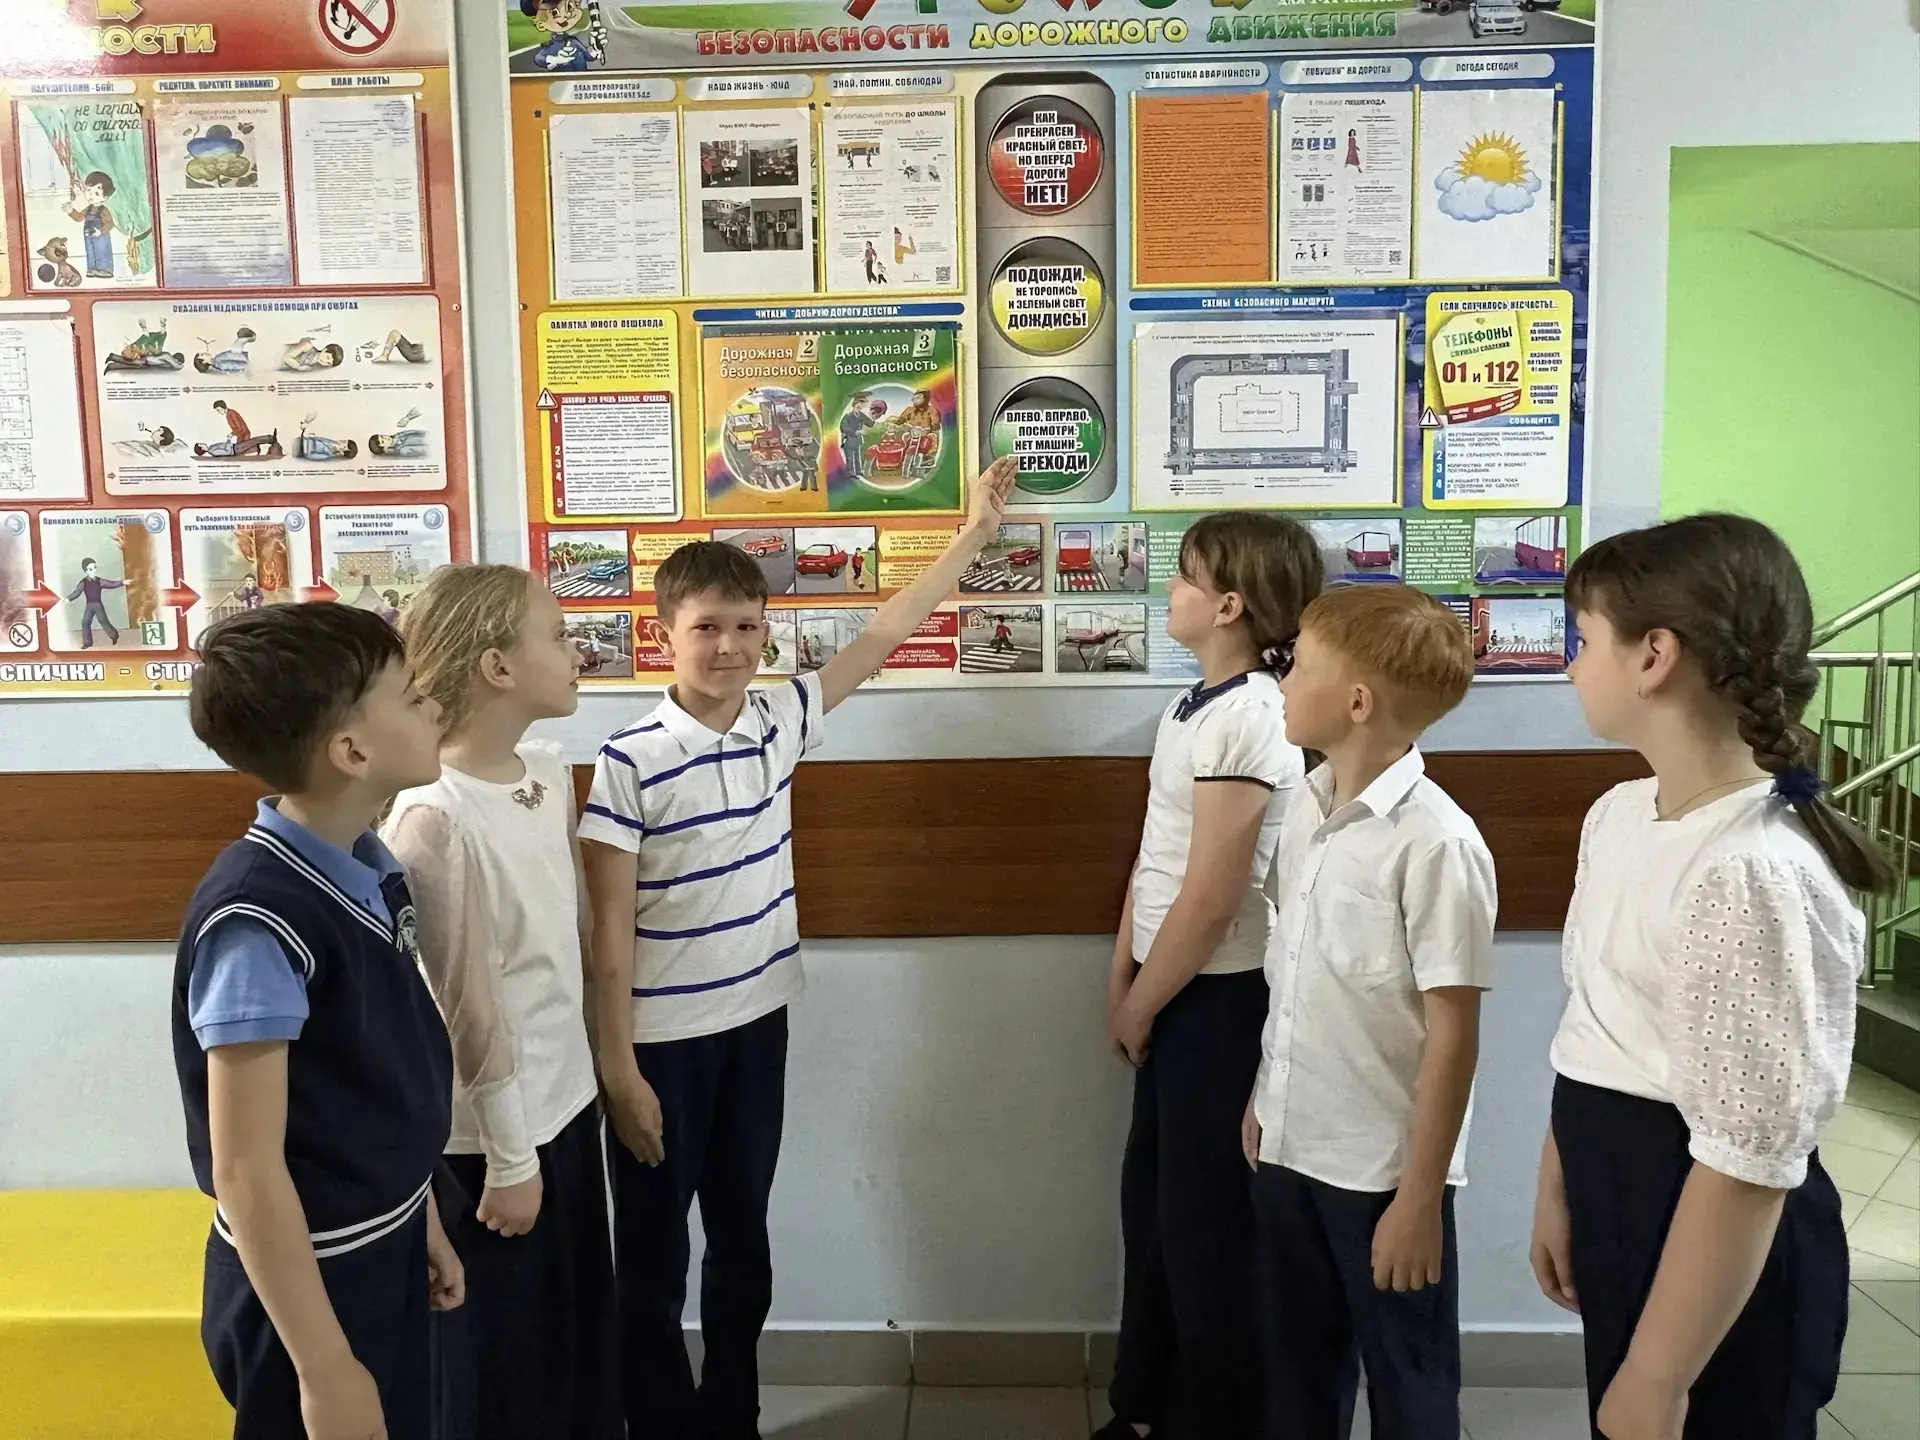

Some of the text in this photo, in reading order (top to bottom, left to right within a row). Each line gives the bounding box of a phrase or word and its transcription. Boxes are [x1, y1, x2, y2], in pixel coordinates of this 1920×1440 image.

[697, 12, 1397, 56] БЕЗОПАСНОСТИ ДОРОЖНОГО ДВИЖЕНИЯ
[1347, 67, 1357, 75] НА
[1358, 66, 1392, 75] ДОРОГАХ
[1456, 62, 1519, 72] ПОГОДА СЕГОДНЯ
[1145, 68, 1261, 80] СТАТИСТИКА АВАРИЙНОСТИ
[199, 79, 232, 90] ОБРАТИТЕ
[235, 79, 273, 89] ВНИМАНИЕ!
[331, 76, 390, 86] ПЛАН РАБОТЫ
[708, 82, 731, 92] НАША
[734, 82, 764, 91] ЖИЗНЬ
[771, 81, 790, 91] ЮИД
[1035, 113, 1056, 123] КАК
[1017, 126, 1074, 138] ПРЕКРАСЕН
[1006, 139, 1086, 152] КРАСНЫЙ СВЕТ,
[1018, 155, 1073, 166] НО ВПЕРЕД
[1025, 169, 1066, 180] ДОРОГИ
[1026, 185, 1066, 203] НЕТ!
[1008, 268, 1086, 284] ПОДОЖДИ,
[1016, 286, 1078, 296] НЕ ТОРОПИСЬ
[173, 303, 212, 313] ОКАЗАНИЕ
[214, 303, 273, 313] МЕДИЦИНСКОЙ
[311, 303, 326, 311] ПРИ
[327, 302, 359, 311] ОЖОГАХ
[1008, 298, 1086, 309] И ЗЕЛЕНЫЙ СВЕТ
[1202, 297, 1334, 308] СХЕМЫ БЕЗОПАСНОГО МАРШРУТА
[1440, 301, 1461, 311] ЕСЛИ
[1462, 301, 1508, 311] СЛУЧИЛОСЬ
[755, 308, 787, 319] ЧИТАЕМ
[830, 307, 861, 318] ДОРОГУ
[551, 319, 664, 329] ПАМЯТКА ЮНОГО ПЕШЕХОДА
[1008, 312, 1087, 330] ДОЖДИСЬ!
[1443, 326, 1513, 347] ТЕЛЕФОНЫ
[719, 339, 814, 363] Дорожная 2
[834, 334, 929, 360] Дорожная 3
[1480, 341, 1510, 353] СПАСЕНИЯ
[720, 364, 820, 378] безопасность
[834, 360, 938, 376] безопасность
[1443, 362, 1467, 383] 01
[1484, 360, 1520, 383] 112
[553, 414, 558, 423] 1
[1045, 411, 1089, 422] ВПРАВО,
[1019, 425, 1078, 436] ПОСМОТРИ:
[555, 446, 561, 455] 2
[1015, 440, 1033, 450] НЕТ
[1035, 440, 1075, 450] МАШИН
[1436, 451, 1442, 460] 2
[555, 459, 561, 468] 3
[1018, 455, 1088, 472] ЕРЕХОДИ
[1436, 464, 1442, 473] 3
[556, 472, 562, 482] 4
[1436, 479, 1442, 489] 4
[557, 498, 563, 507] 5
[0, 663, 104, 682] спички
[145, 662, 201, 682] стр
